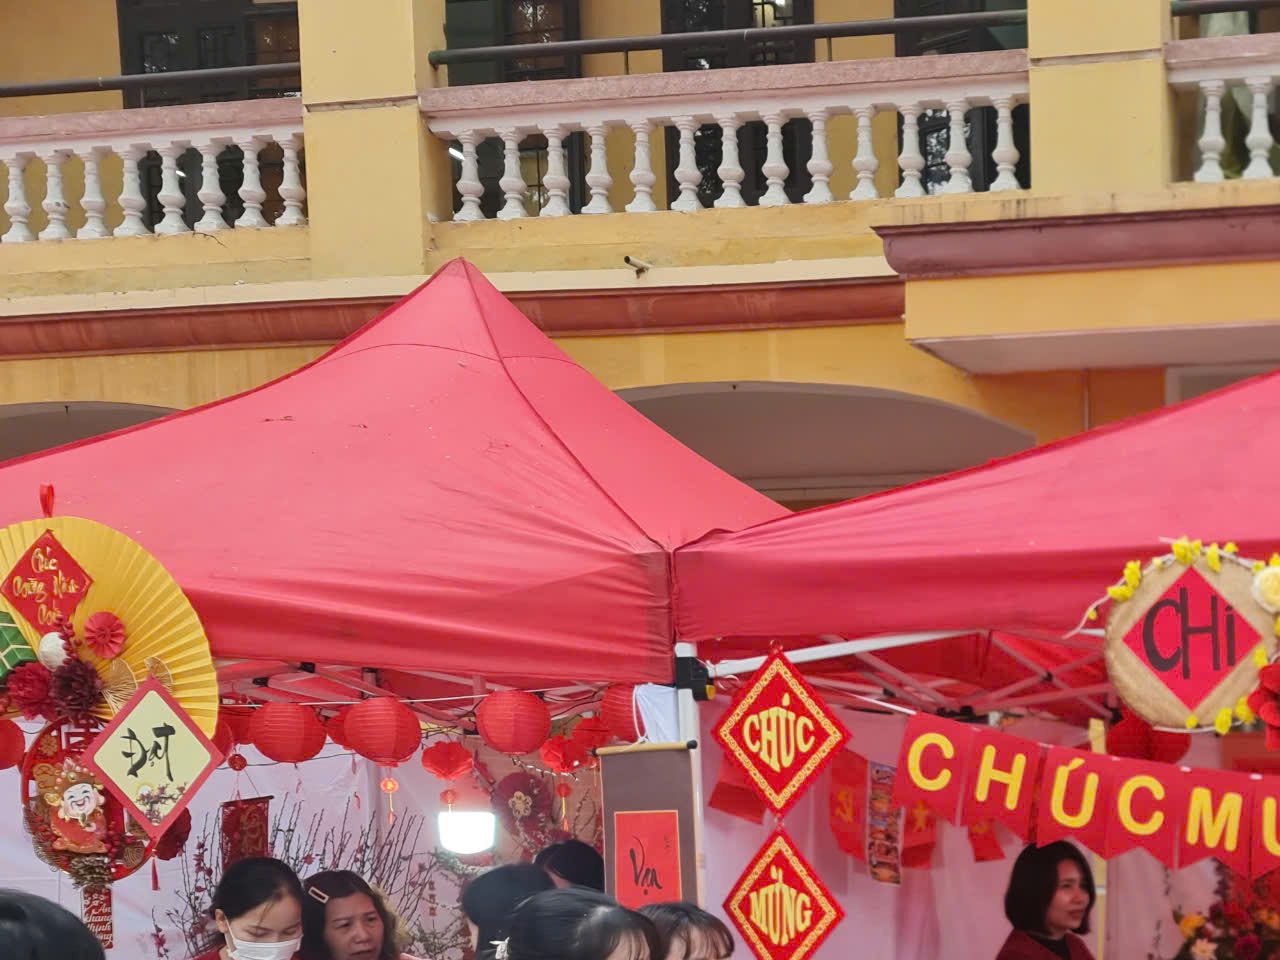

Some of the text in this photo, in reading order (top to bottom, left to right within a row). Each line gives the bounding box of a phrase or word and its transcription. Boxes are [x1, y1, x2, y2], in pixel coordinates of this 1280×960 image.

[743, 692, 815, 773] CHÚC
[907, 732, 1166, 836] CHÚC
[749, 865, 813, 946] MỪNG
